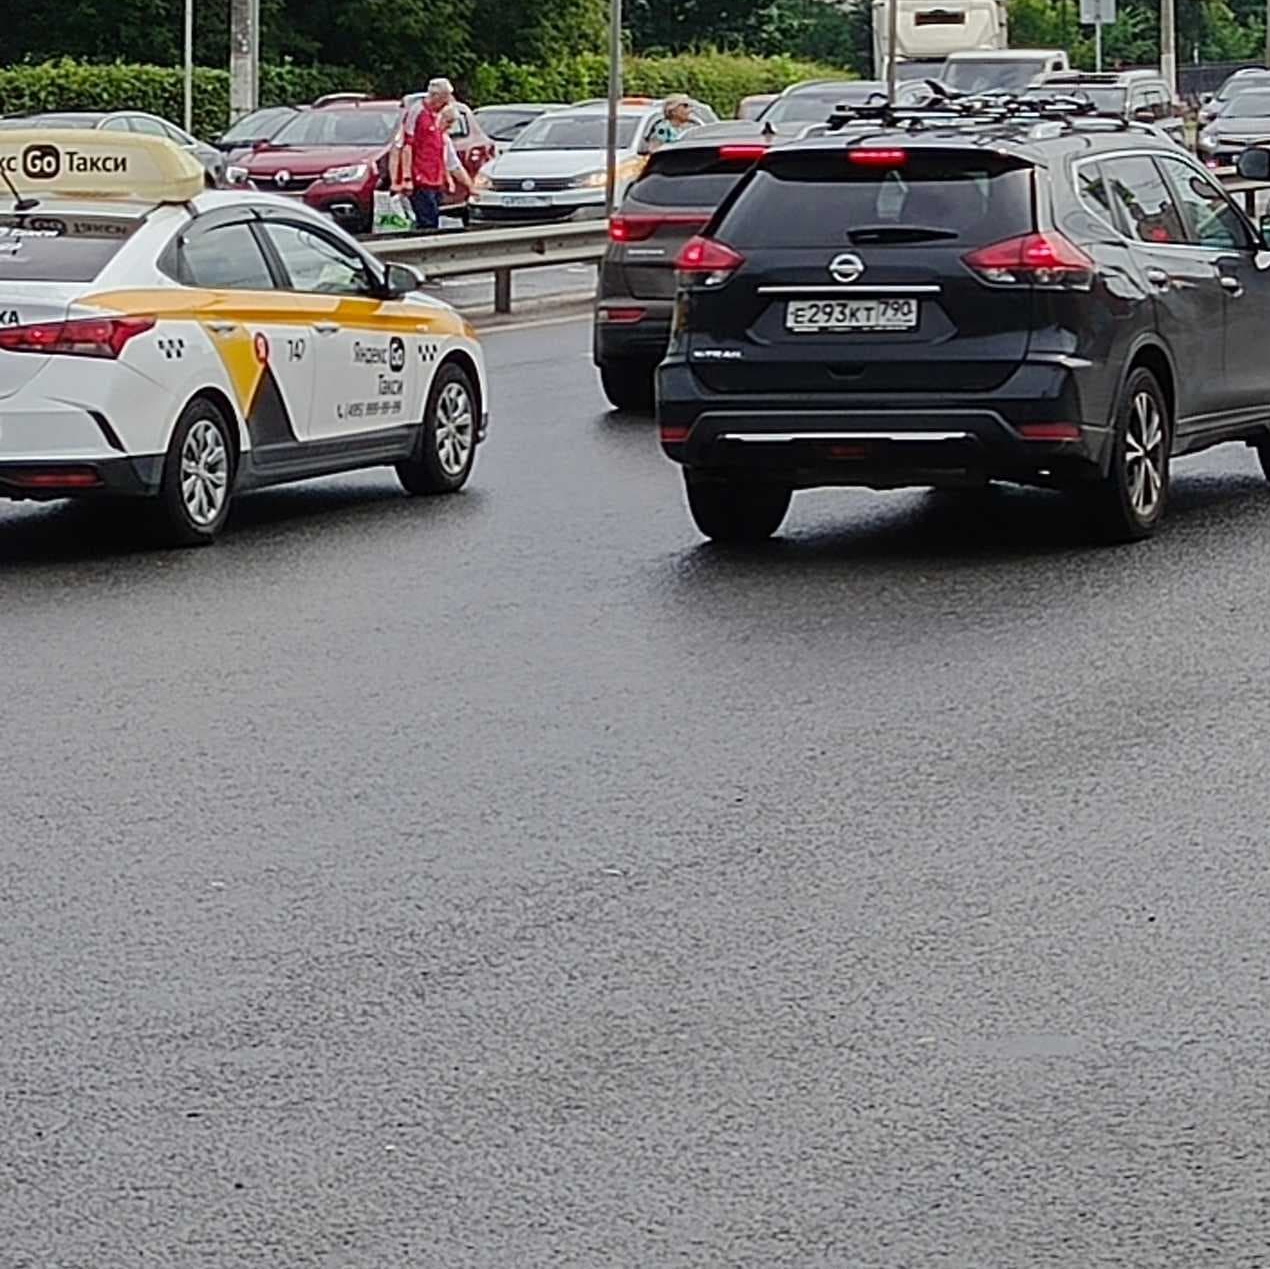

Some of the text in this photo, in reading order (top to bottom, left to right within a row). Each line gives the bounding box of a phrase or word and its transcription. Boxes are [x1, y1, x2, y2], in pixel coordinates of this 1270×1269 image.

[26, 150, 57, 173] Go
[65, 151, 128, 172] Такси
[794, 300, 913, 324] Е293КТ 790
